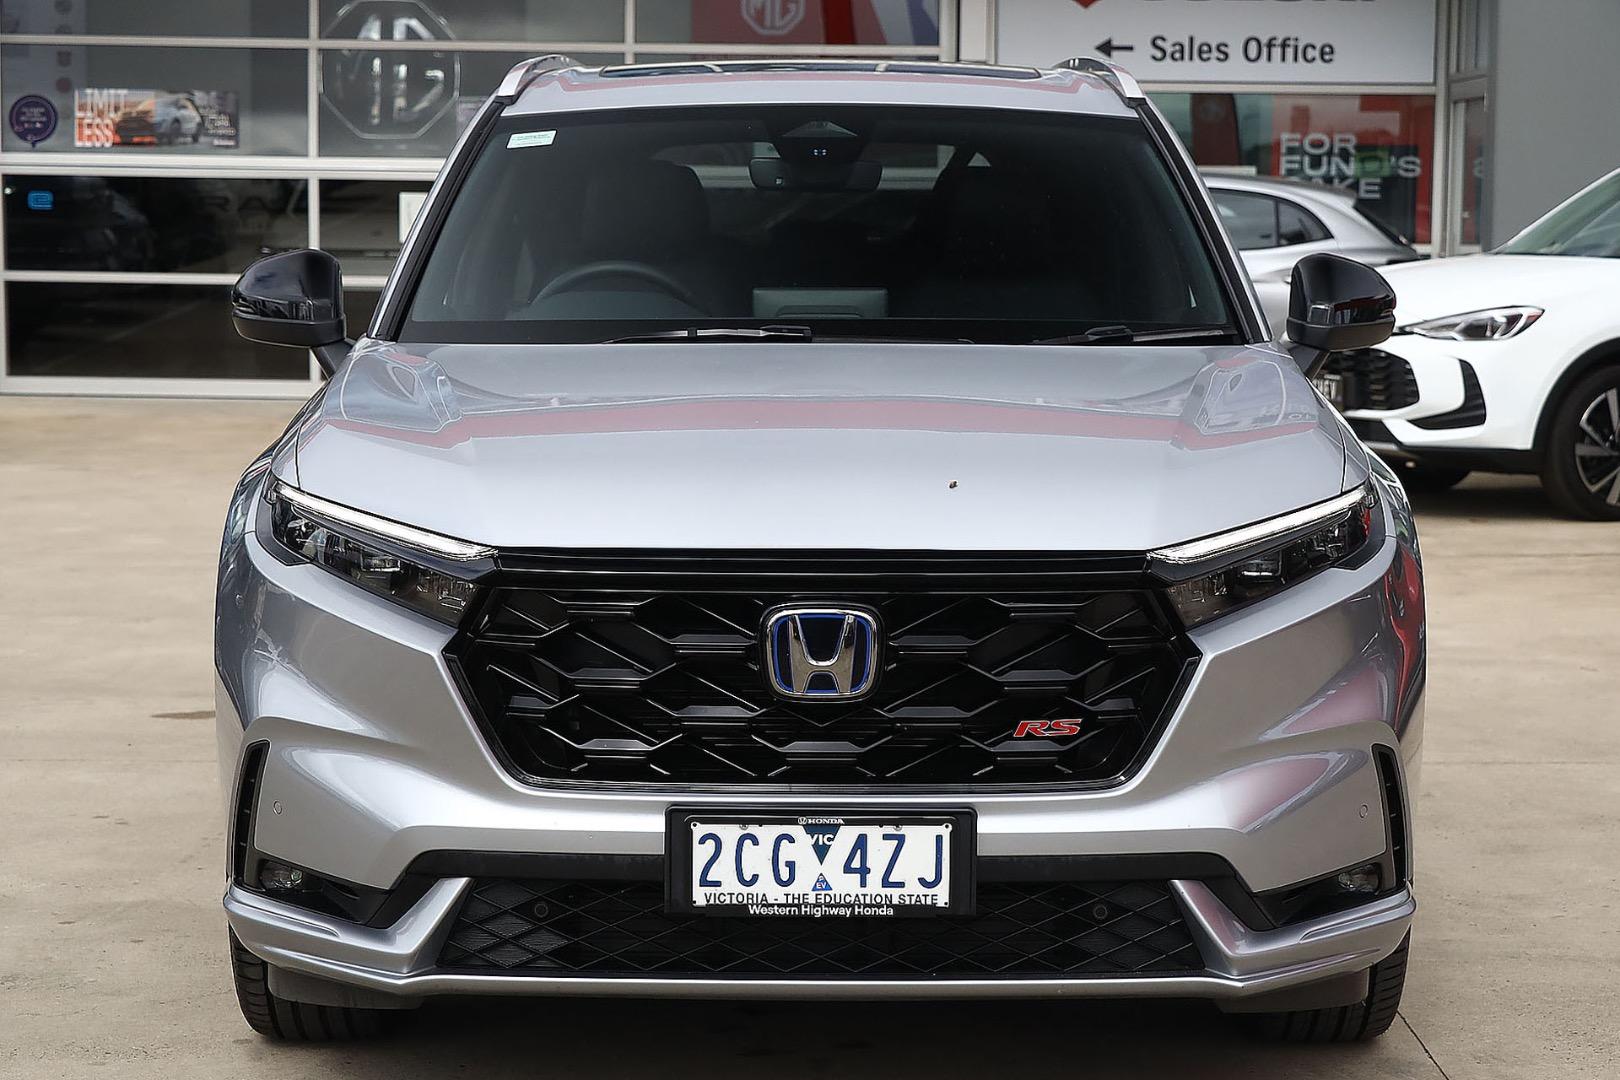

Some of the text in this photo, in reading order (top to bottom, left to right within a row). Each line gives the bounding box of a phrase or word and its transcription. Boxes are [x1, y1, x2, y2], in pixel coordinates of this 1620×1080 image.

[1150, 35, 1336, 64] Sales Office
[74, 87, 129, 118] LIMIT
[74, 116, 114, 148] LESS
[1279, 131, 1357, 155] FOR
[1012, 718, 1083, 737] RS
[808, 833, 835, 846] VIC
[698, 832, 944, 889] 2CG 4ZJ
[815, 881, 827, 890] EV
[704, 892, 769, 904] VICTORIA
[783, 893, 810, 904] THE
[814, 893, 893, 905] EDUCATION
[898, 893, 939, 905] STATE
[748, 904, 894, 918] Western Highway Honda
